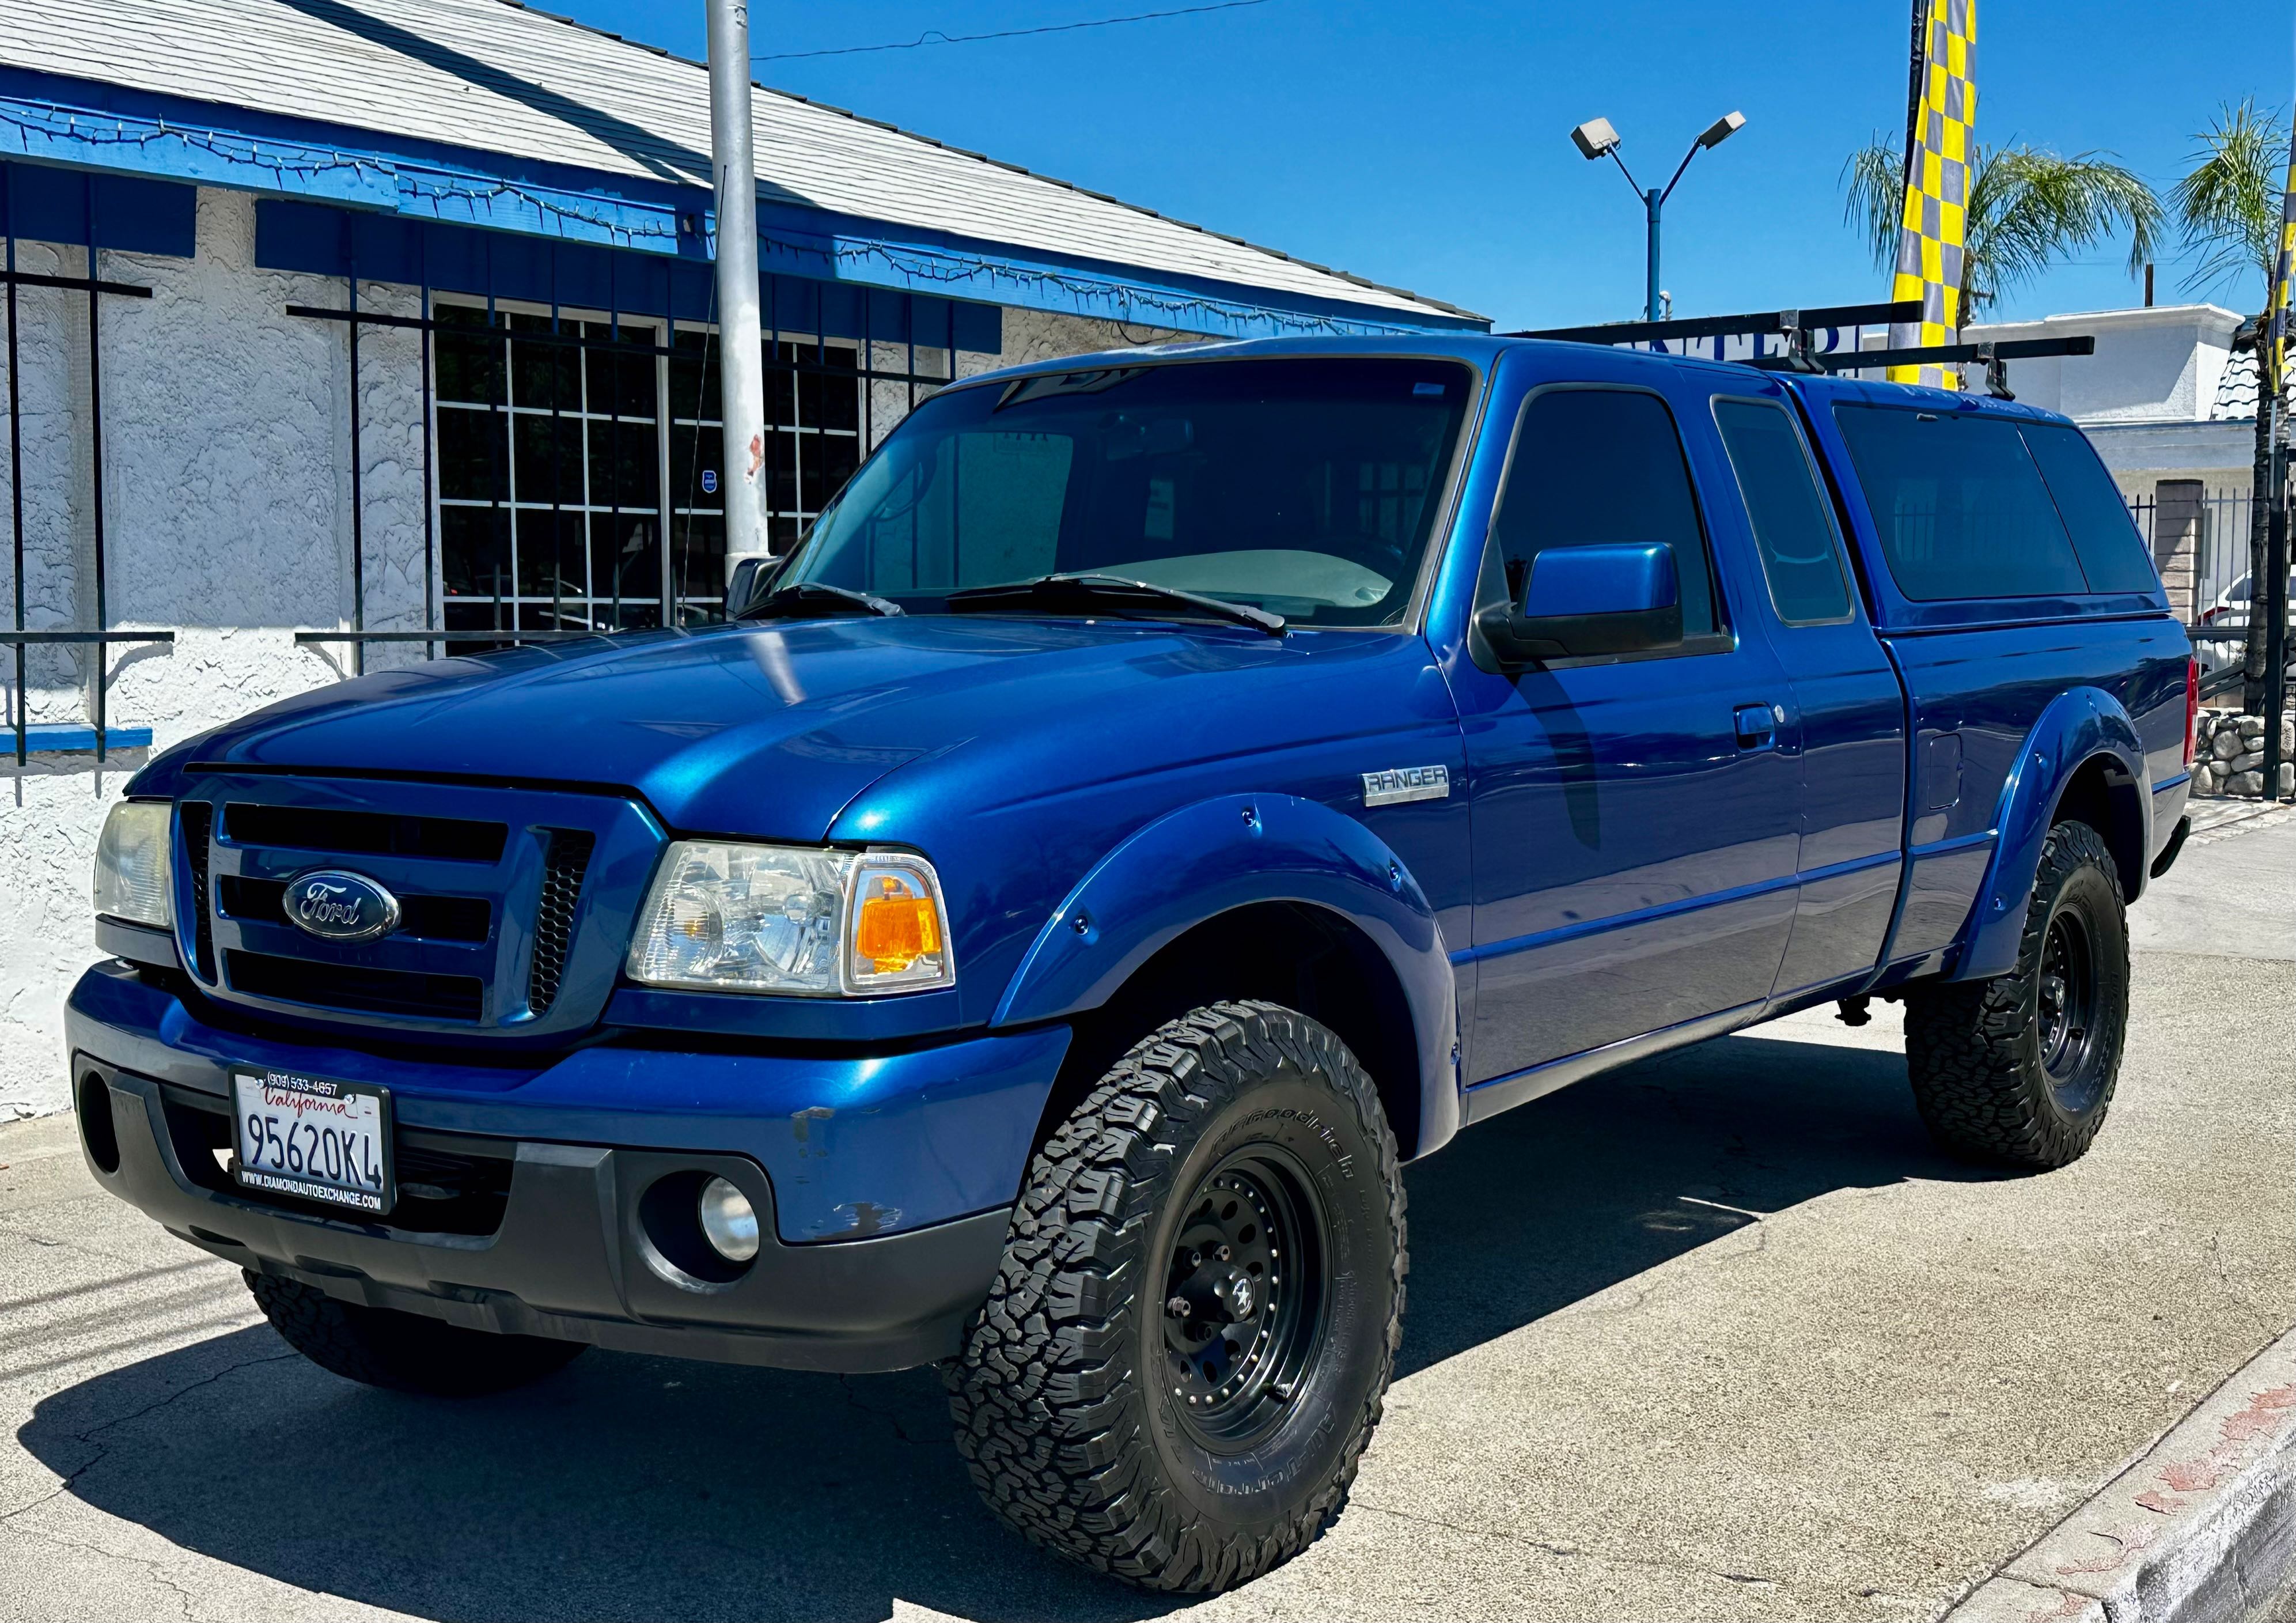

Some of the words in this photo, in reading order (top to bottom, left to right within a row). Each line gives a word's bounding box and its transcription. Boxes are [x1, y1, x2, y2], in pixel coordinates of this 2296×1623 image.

[1367, 767, 1448, 793] RANGER
[301, 883, 362, 925] Ford
[267, 1071, 290, 1088] (909)
[290, 1077, 338, 1095] 533-4657
[263, 1085, 358, 1118] California
[248, 1113, 382, 1190] 95620K4
[241, 1170, 381, 1210] WWW.DIAMONDAUTOEXCHANGE.COM
